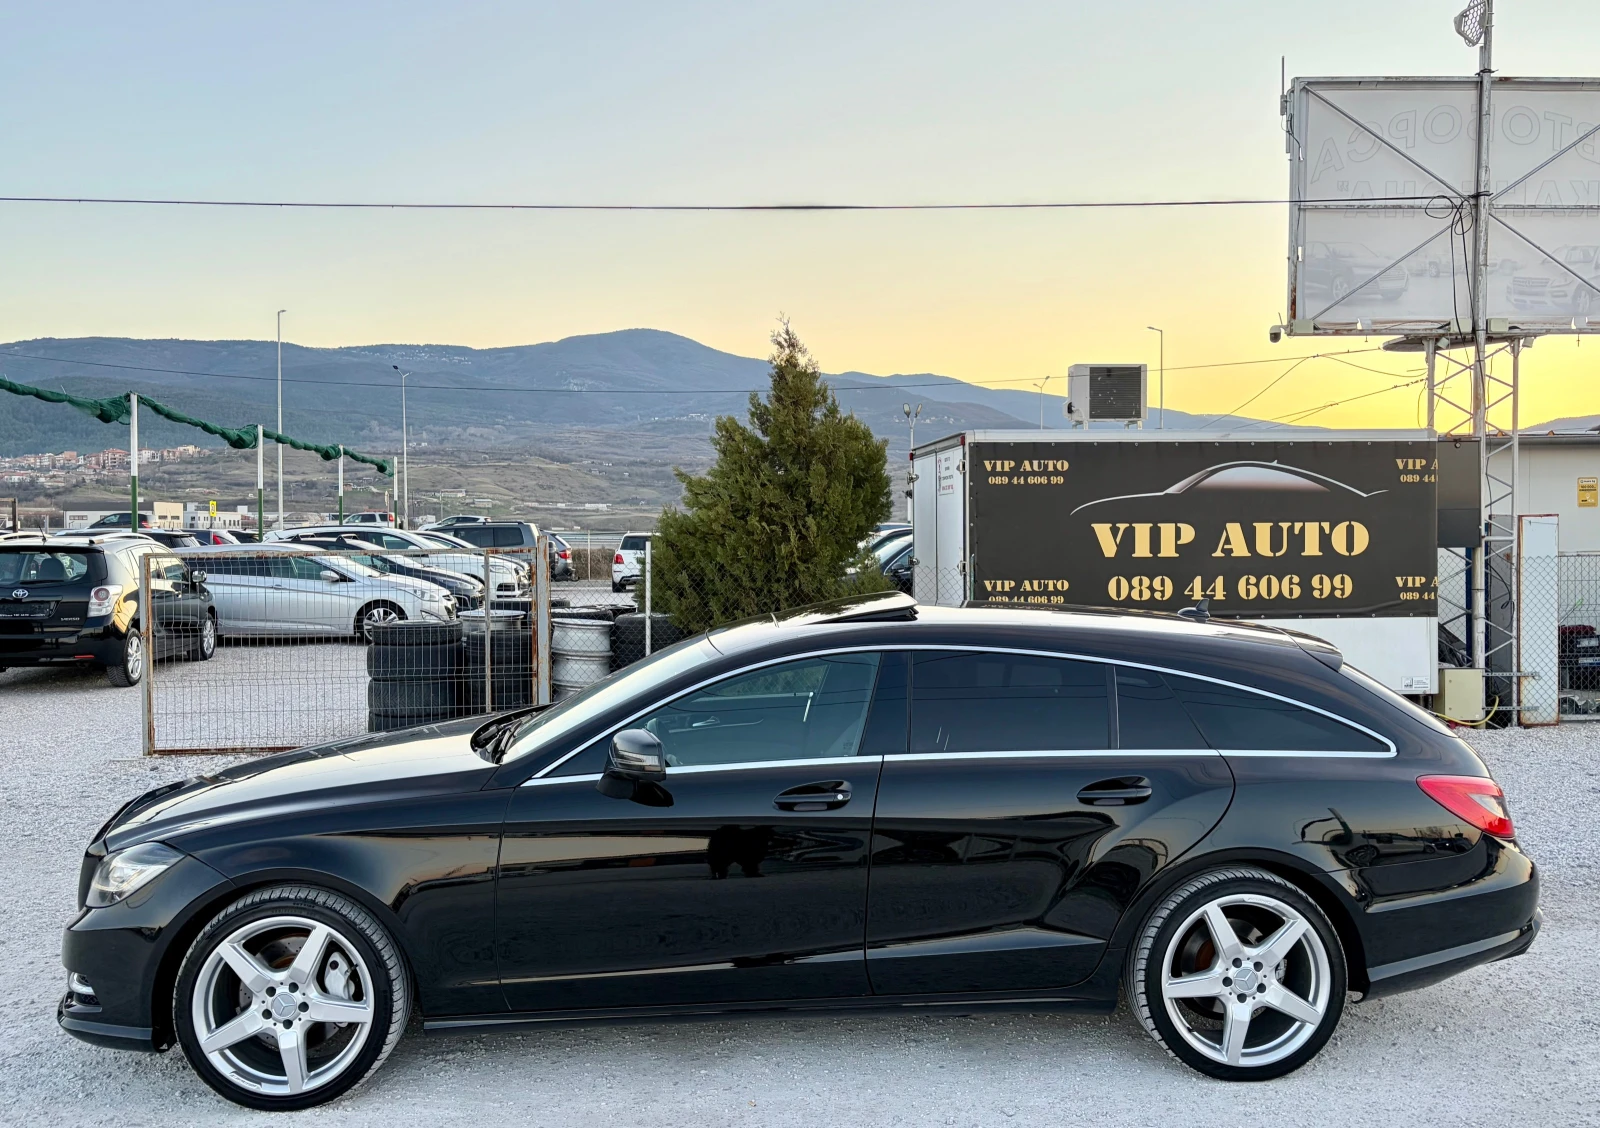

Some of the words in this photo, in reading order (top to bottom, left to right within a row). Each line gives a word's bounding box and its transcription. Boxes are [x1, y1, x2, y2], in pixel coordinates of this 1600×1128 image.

[984, 460, 1016, 472] VIP
[1019, 460, 1070, 472] AUTO
[1395, 459, 1427, 470] VIP
[988, 476, 1009, 485] 089
[1011, 476, 1025, 485] 44
[1027, 476, 1048, 485] 606
[1050, 476, 1065, 485] 99
[1400, 474, 1420, 483] 089
[1422, 474, 1435, 483] 44
[1091, 523, 1196, 558] VIP
[1211, 520, 1370, 557] AUTO
[984, 580, 1016, 592] VIP
[1020, 579, 1070, 592] AUTO
[1107, 575, 1174, 601] 089
[1183, 575, 1227, 601] 44
[1237, 574, 1302, 600] 606
[1311, 573, 1353, 599] 99
[1395, 576, 1427, 588] VIP
[1027, 595, 1049, 604] 606
[1050, 595, 1065, 604] 99
[1400, 592, 1420, 601] 089
[1422, 592, 1435, 600] 44
